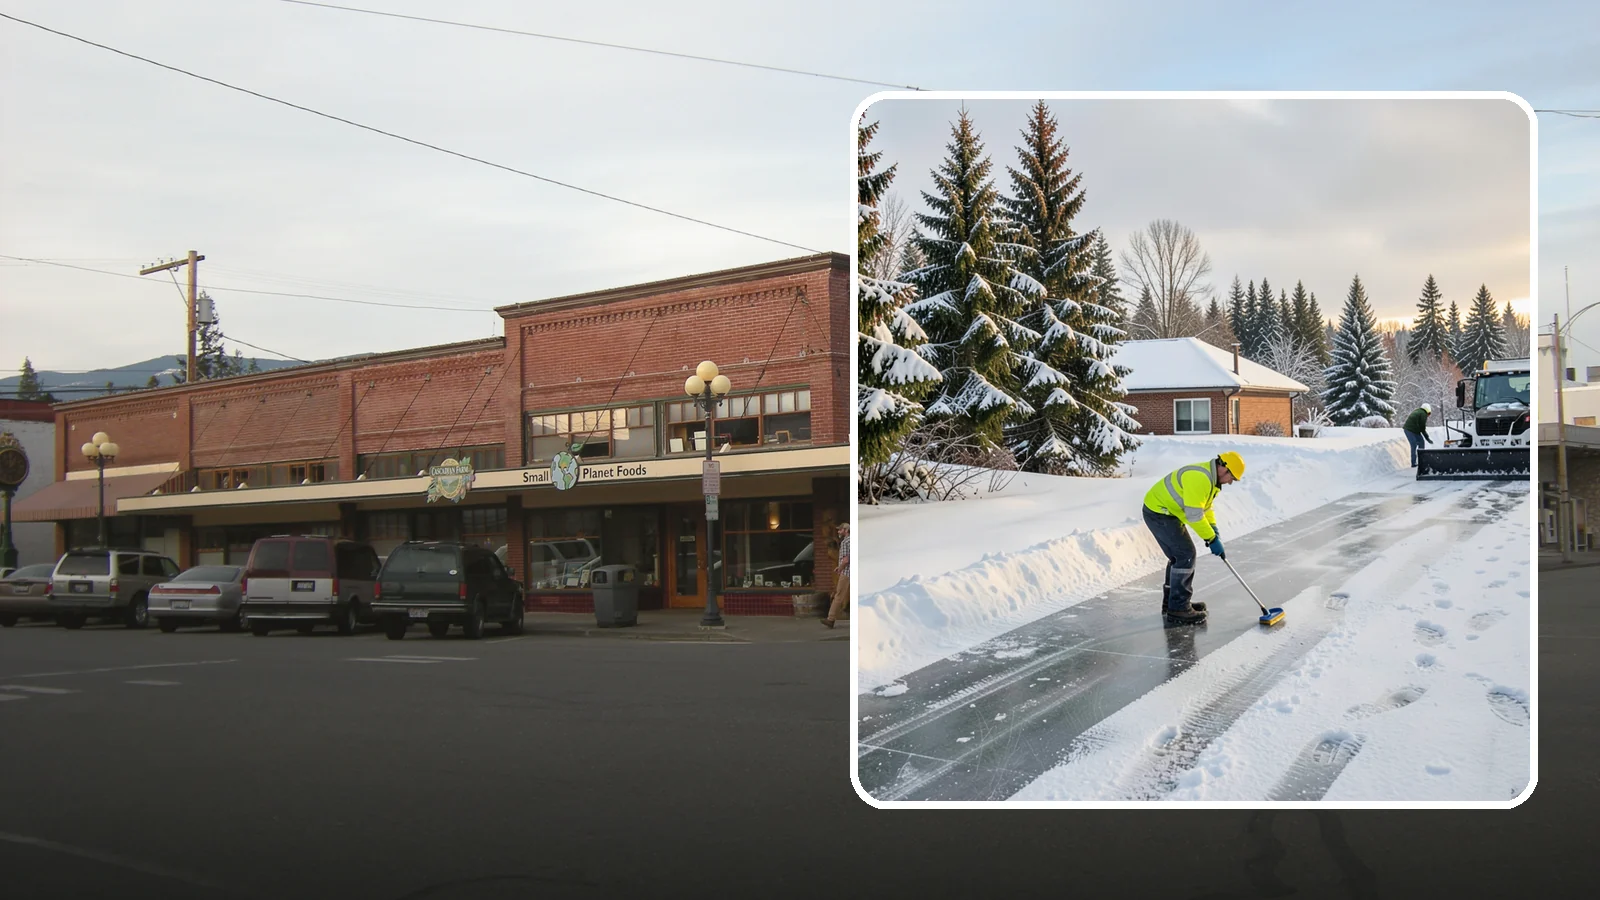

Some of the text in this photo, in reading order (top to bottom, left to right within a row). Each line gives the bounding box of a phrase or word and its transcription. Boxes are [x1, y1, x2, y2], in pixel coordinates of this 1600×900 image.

[523, 464, 647, 483] Small Planet Foods
